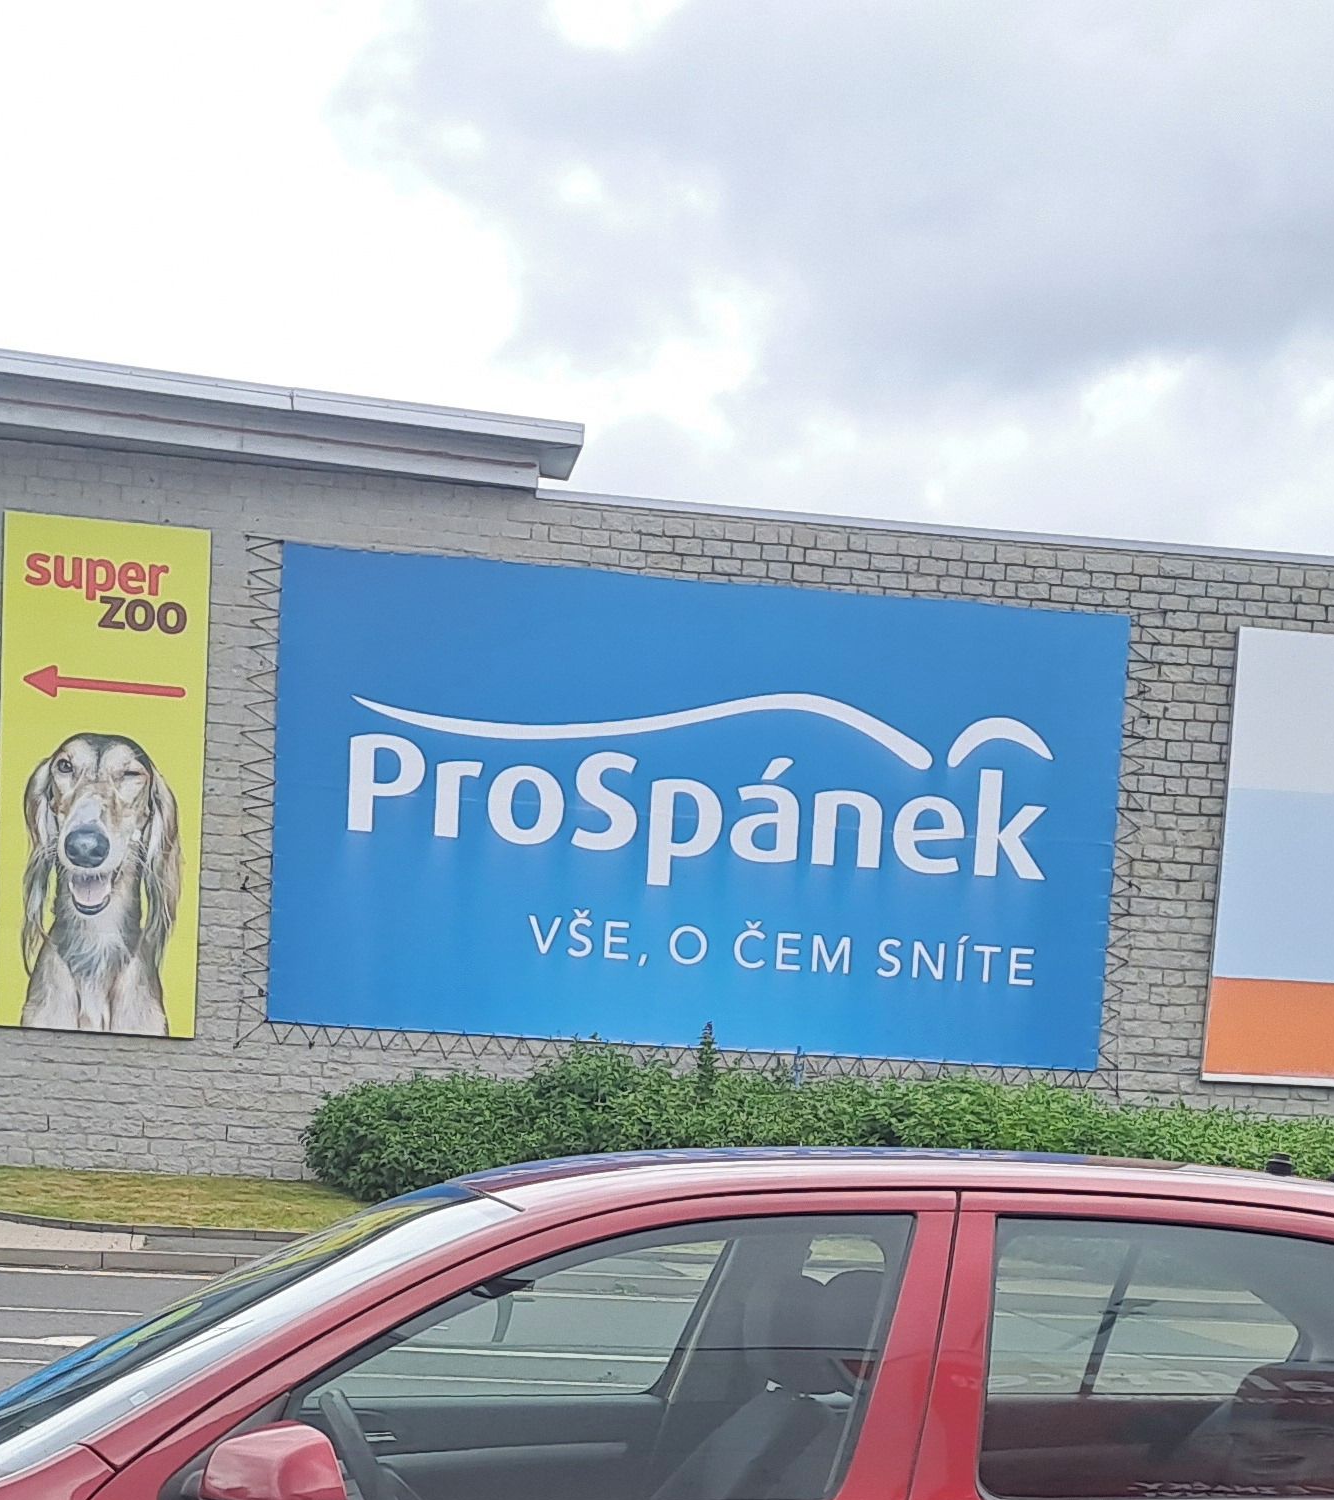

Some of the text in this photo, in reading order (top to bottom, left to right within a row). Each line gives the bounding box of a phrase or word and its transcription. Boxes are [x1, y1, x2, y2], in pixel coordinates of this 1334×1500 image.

[24, 552, 170, 602] super
[98, 595, 188, 635] zoo
[346, 733, 1048, 886] ProSpánek
[528, 908, 1035, 987] VŠE, O ČEM SNÍTE
